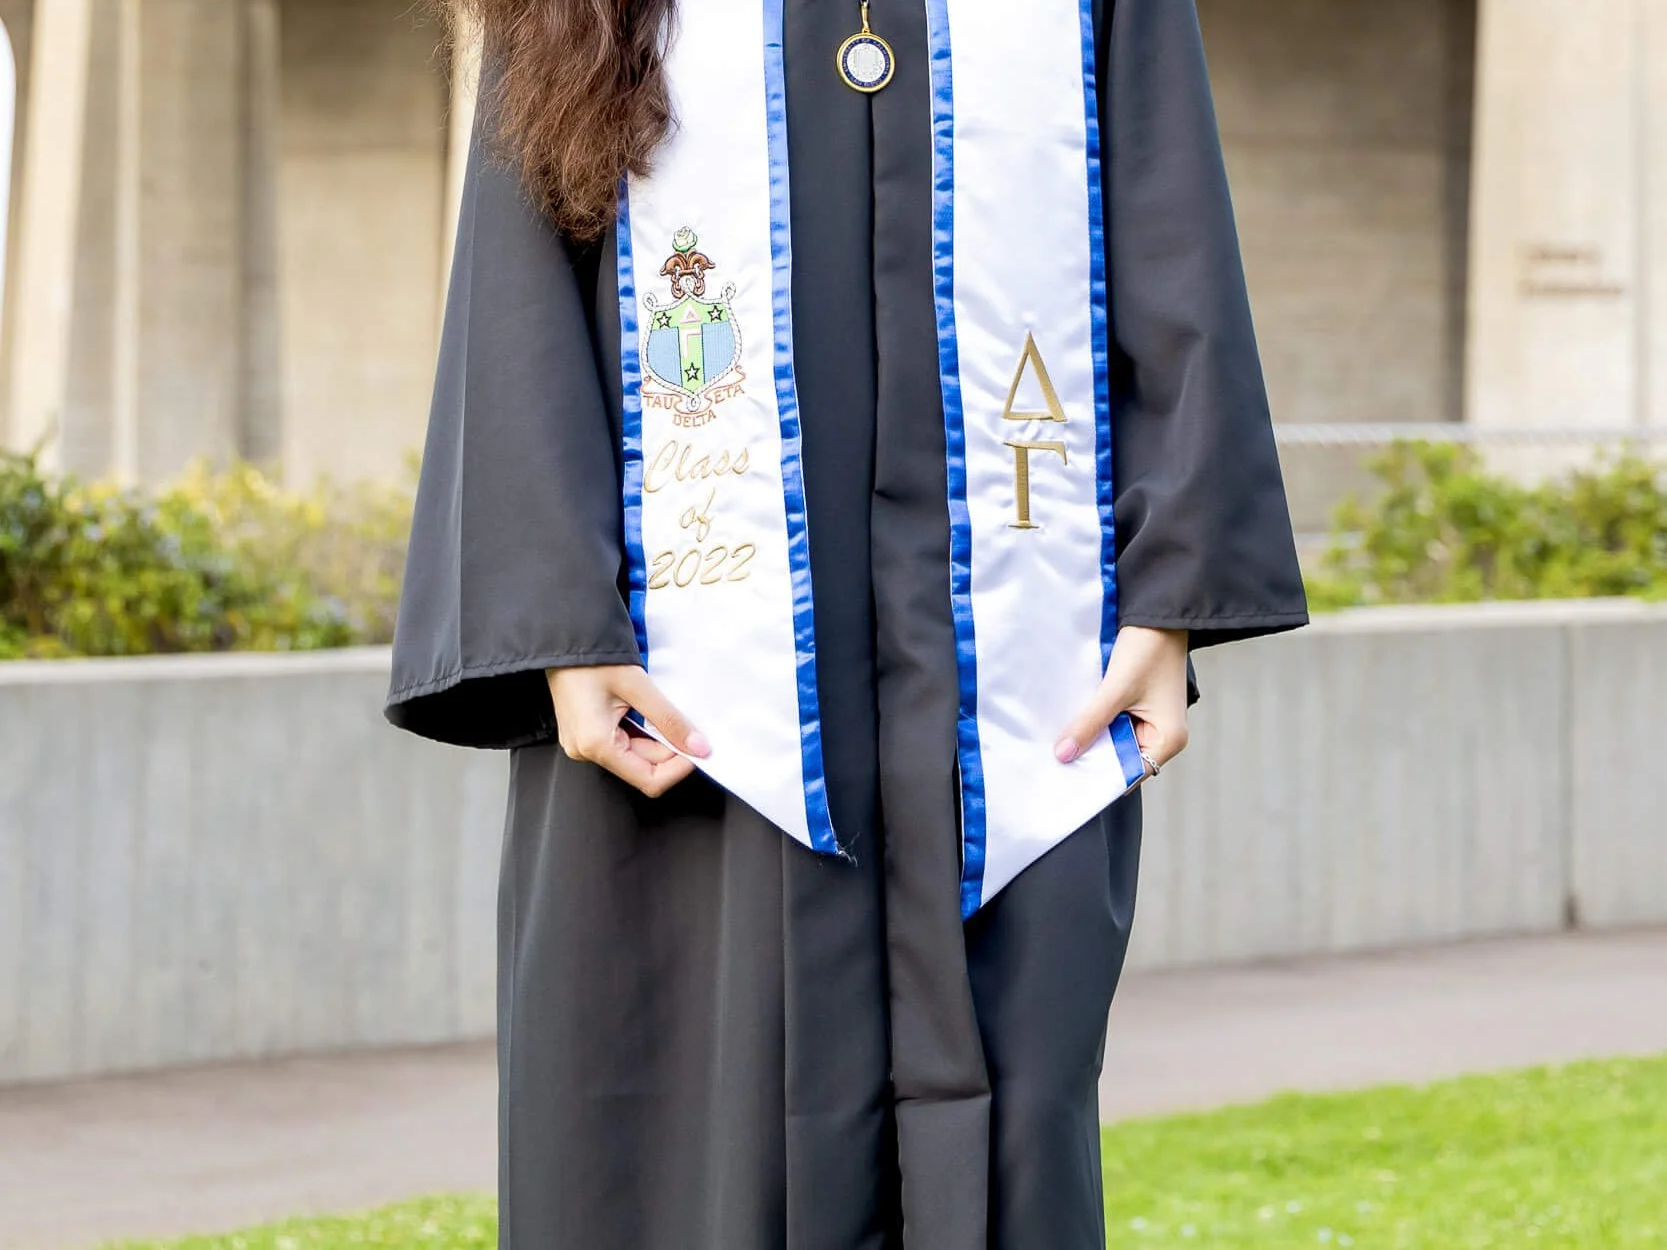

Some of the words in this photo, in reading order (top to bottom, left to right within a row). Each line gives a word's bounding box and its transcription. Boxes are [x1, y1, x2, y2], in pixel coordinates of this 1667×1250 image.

[1003, 330, 1067, 422] Δ
[644, 395, 675, 410] TAU
[672, 410, 717, 428] DELTA
[713, 384, 745, 404] ETA
[643, 439, 750, 494] Class
[1003, 440, 1068, 529] Γ
[679, 487, 714, 542] of
[648, 541, 757, 590] 2022
